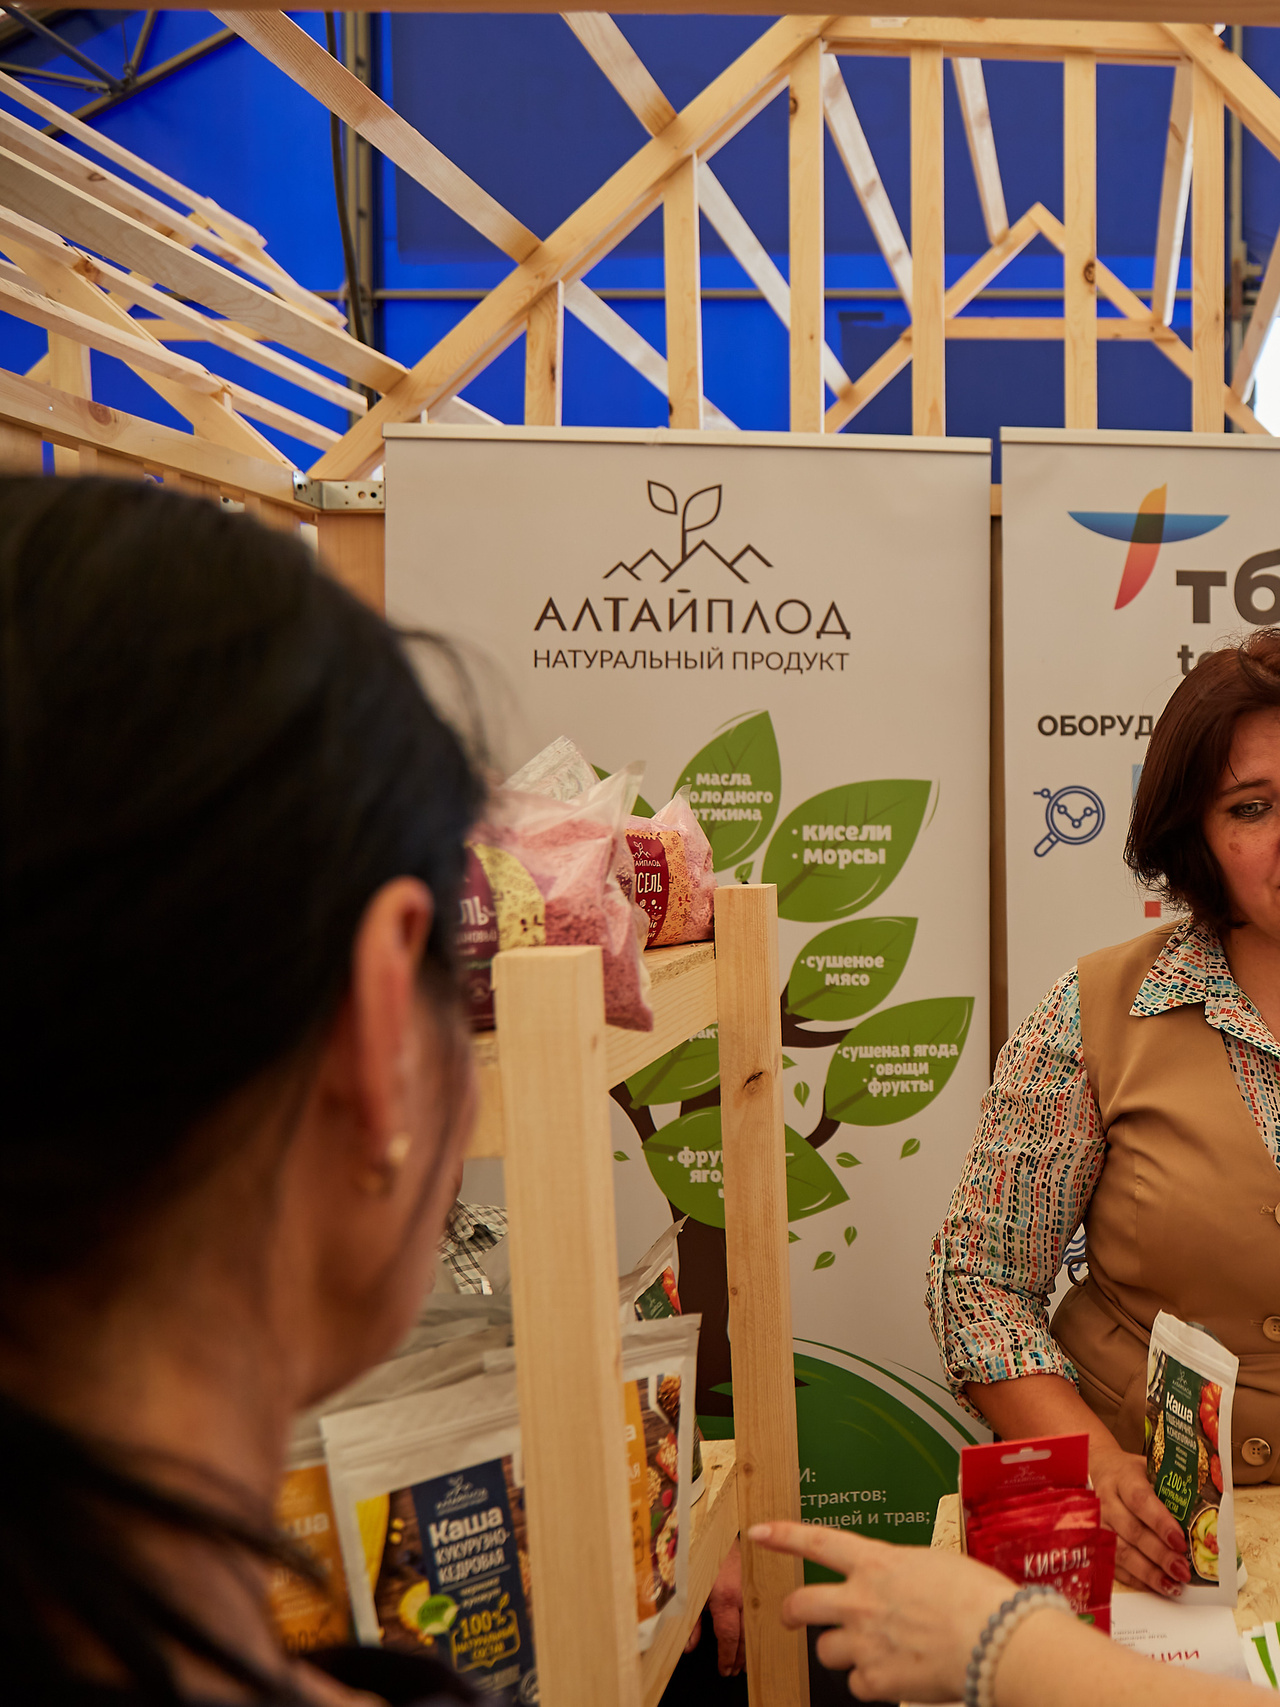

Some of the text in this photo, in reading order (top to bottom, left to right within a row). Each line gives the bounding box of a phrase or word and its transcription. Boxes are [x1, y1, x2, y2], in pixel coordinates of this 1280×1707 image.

[533, 588, 851, 639] АЛТАЙПЛОД
[533, 646, 849, 675] НАТУРАЛЬНЫЙ ПРОДУКТ
[1037, 714, 1154, 740] ОБОРУД
[696, 773, 752, 787] масла
[690, 790, 773, 806] олодного
[802, 825, 892, 842] кисели
[803, 848, 886, 869] морсы
[636, 872, 663, 894] СЕЛЬ
[806, 954, 884, 972] сушеное
[825, 972, 870, 987] мясо
[841, 1042, 959, 1060] сушеная ягода
[876, 1061, 929, 1077] овощи
[867, 1076, 934, 1097] фрукты
[677, 1146, 724, 1169] фру
[689, 1169, 725, 1185] яго
[1165, 1391, 1194, 1425] Каша
[430, 1506, 504, 1548] Каша
[883, 1510, 931, 1527] трав;
[1024, 1545, 1091, 1579] КИСЕЛЬ
